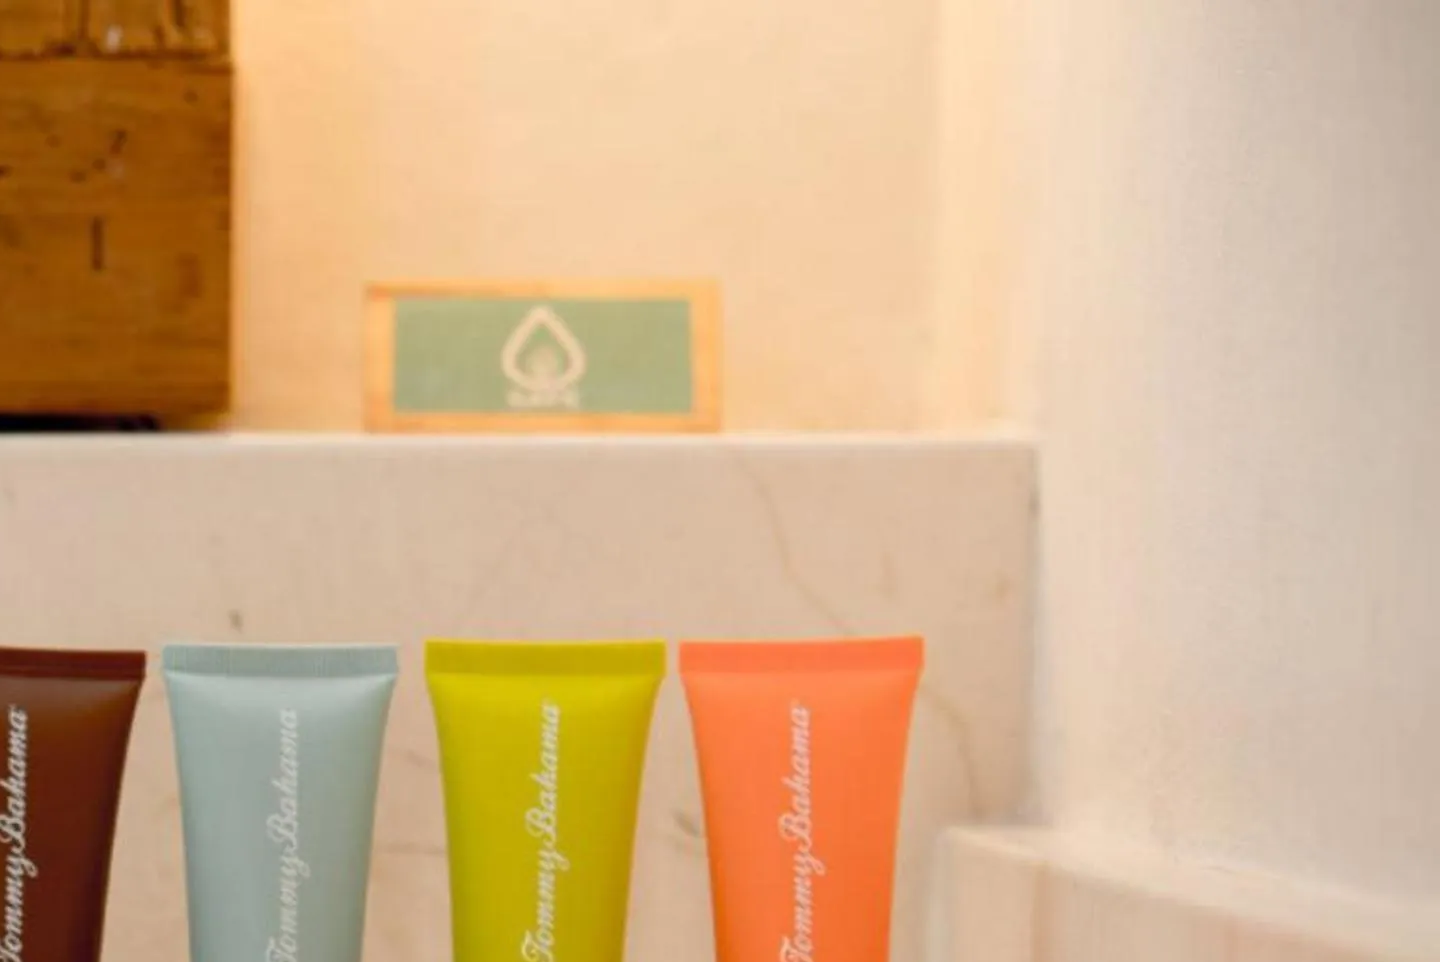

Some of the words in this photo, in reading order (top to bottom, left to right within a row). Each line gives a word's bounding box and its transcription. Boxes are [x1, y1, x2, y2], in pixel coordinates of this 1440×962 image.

[266, 706, 298, 852] Bahama
[524, 702, 560, 846] Bahama
[777, 703, 812, 851] Bahama
